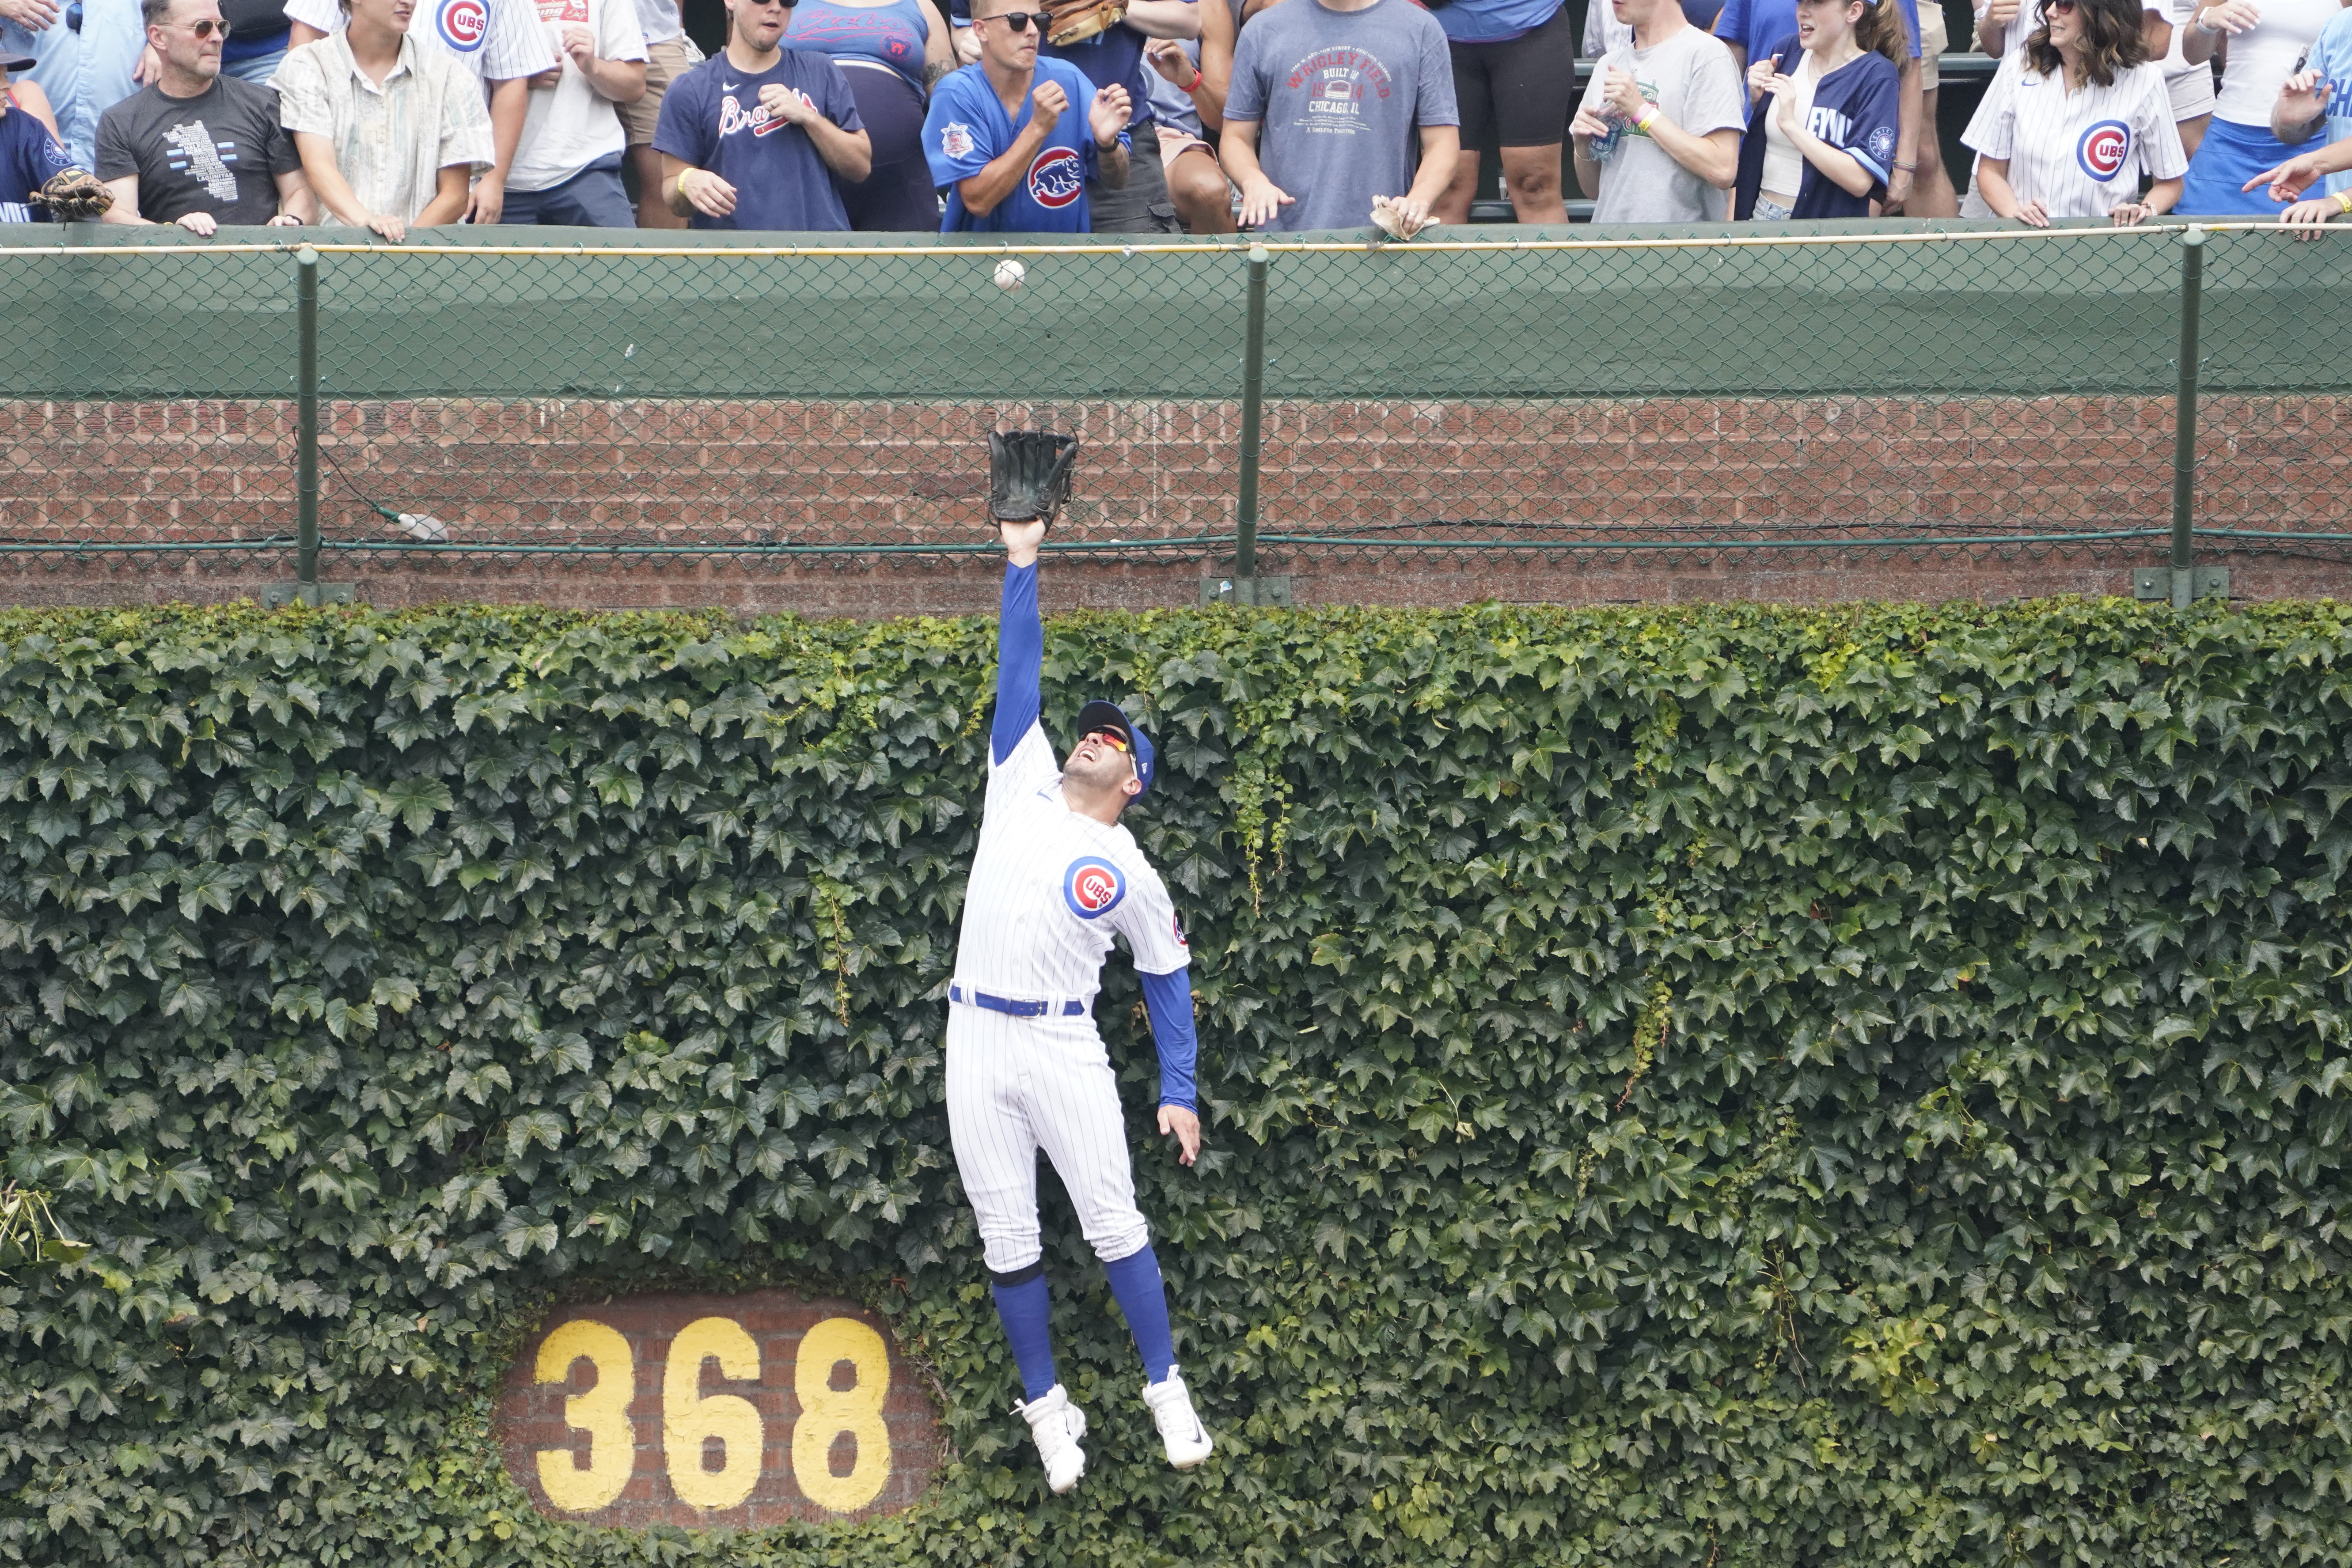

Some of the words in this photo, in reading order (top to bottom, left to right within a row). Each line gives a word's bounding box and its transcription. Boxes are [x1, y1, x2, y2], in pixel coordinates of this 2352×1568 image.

[446, 0, 484, 41] CUBS
[539, 8, 565, 16] ing
[785, 9, 914, 38] Cubs
[1286, 52, 1359, 89] WRIGLEY
[1359, 58, 1390, 98] FIELD
[1308, 47, 1330, 59] ADDON
[1377, 61, 1392, 82] ILLINOIS
[1323, 68, 1349, 79] BUILT
[1350, 70, 1359, 80] IN
[1312, 82, 1324, 97] 19
[1351, 102, 1360, 114] IL
[2088, 130, 2124, 171] CUBS
[197, 172, 233, 182] LAGUNITAS
[1075, 867, 1115, 909] CUBS
[534, 1317, 892, 1513] 368
